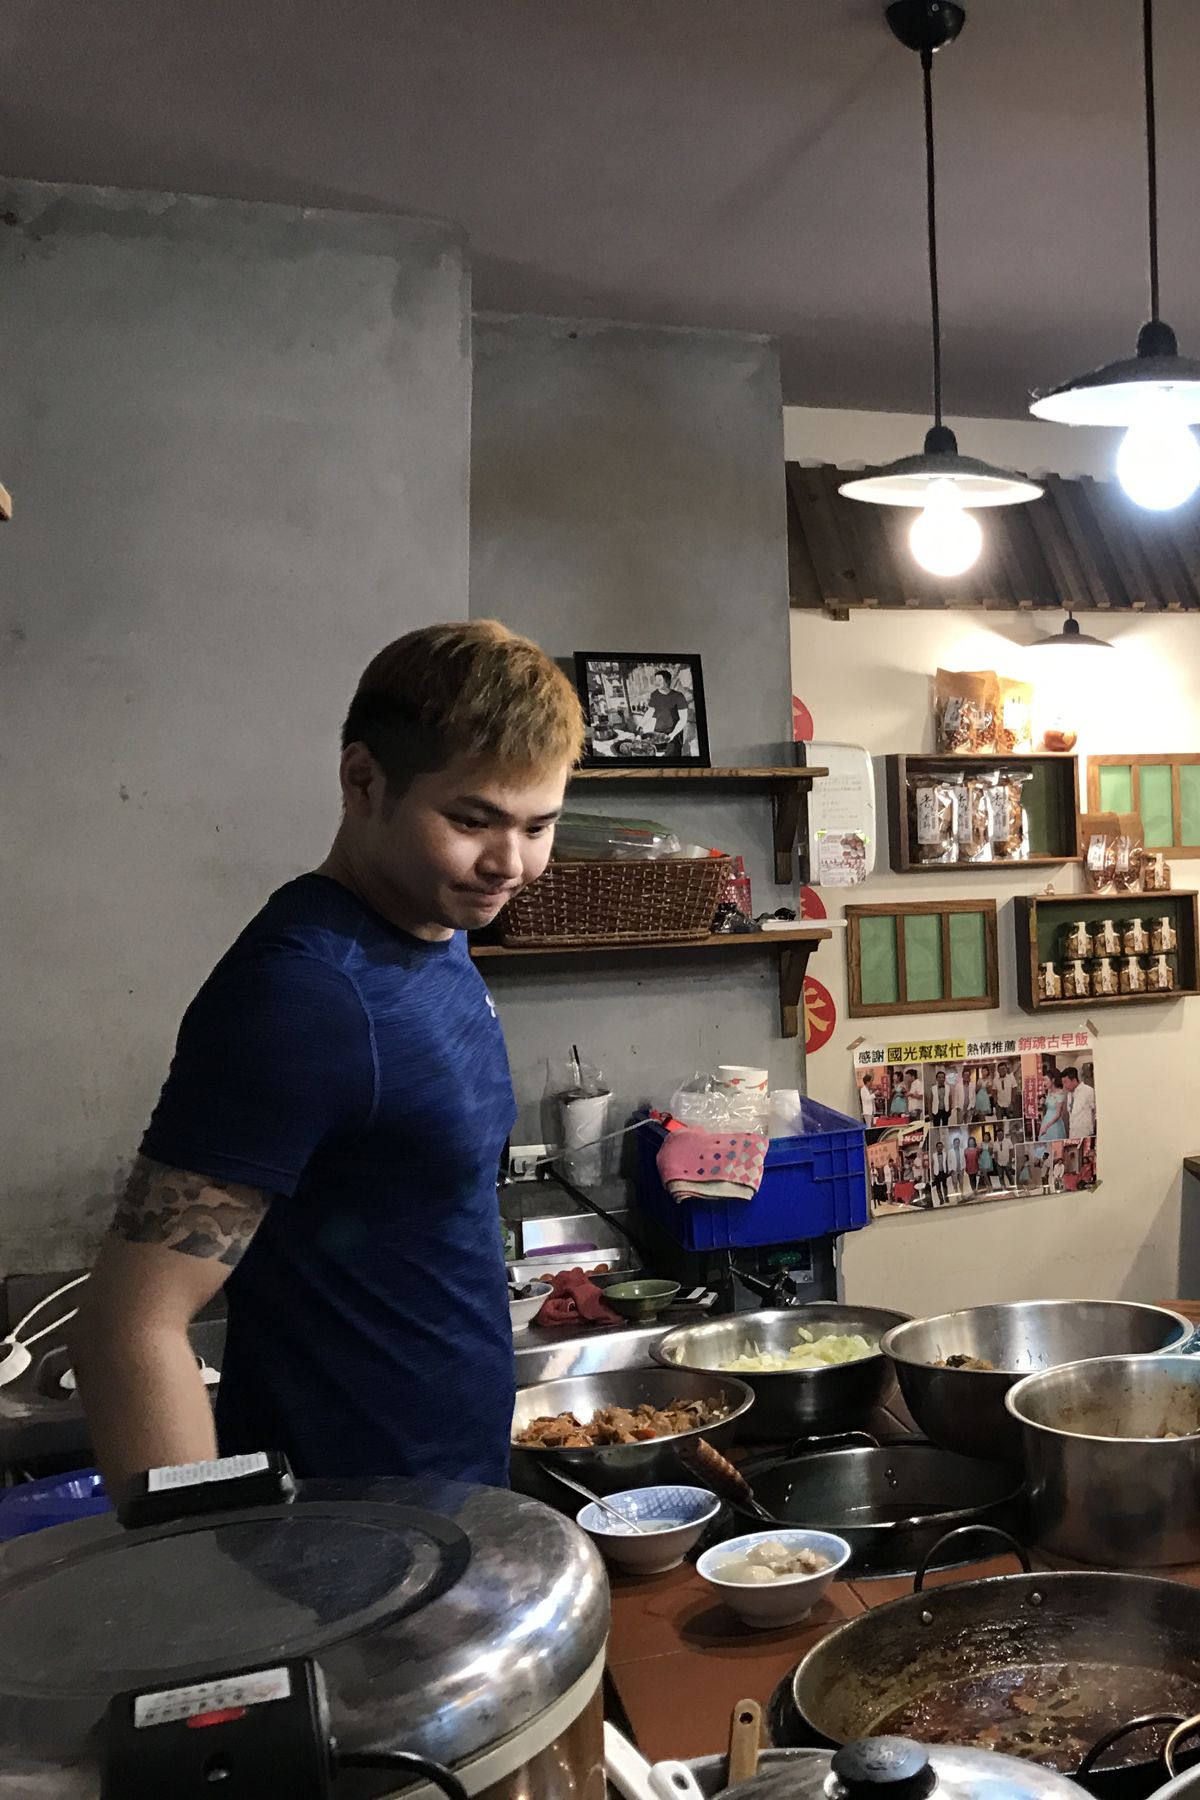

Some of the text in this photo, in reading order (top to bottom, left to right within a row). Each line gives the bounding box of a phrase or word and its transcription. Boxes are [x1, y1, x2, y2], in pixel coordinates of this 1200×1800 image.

[859, 1049, 884, 1063] 感謝
[967, 1040, 1015, 1056] 熱情推薦
[1018, 1032, 1089, 1051] 銷魂古早飯
